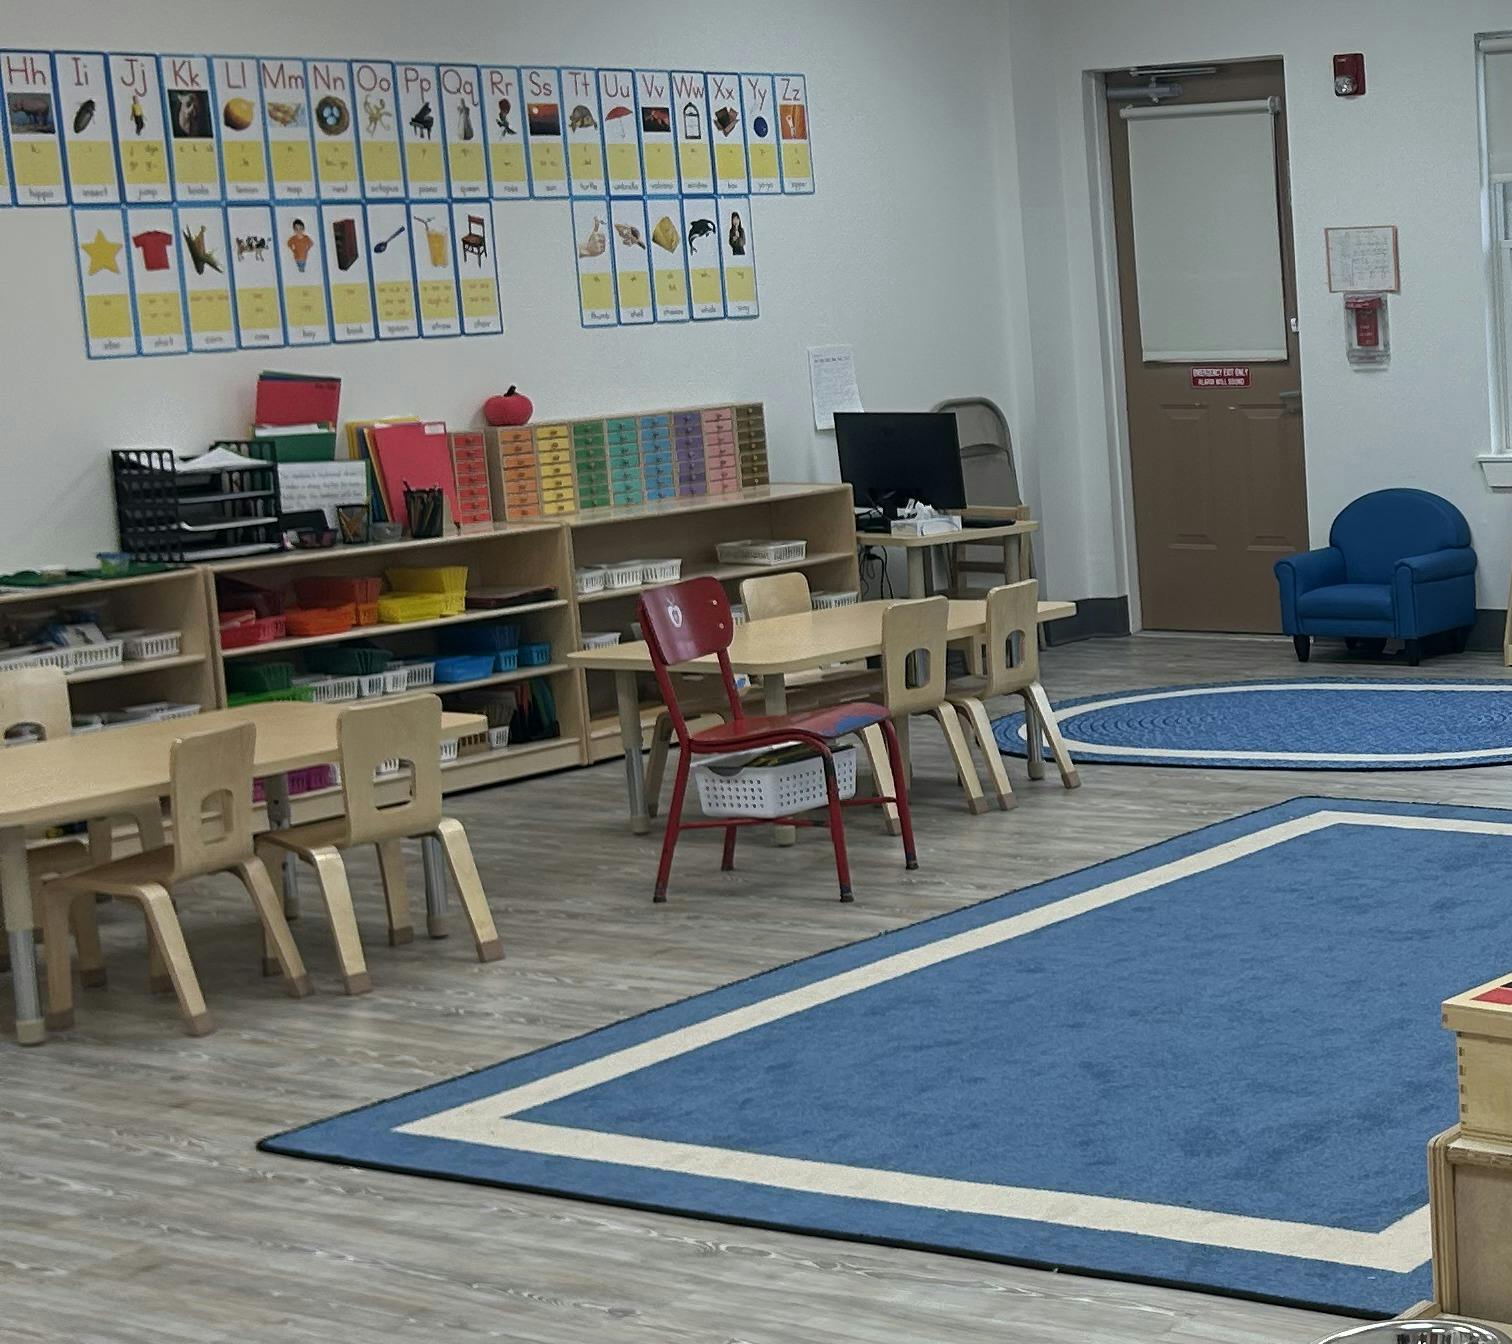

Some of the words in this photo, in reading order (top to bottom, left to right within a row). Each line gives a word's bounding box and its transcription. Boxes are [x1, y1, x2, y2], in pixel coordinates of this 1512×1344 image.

[7, 56, 46, 85] Hh
[72, 58, 88, 86] Ii
[120, 59, 147, 97] Jj
[172, 60, 200, 86] Kk
[225, 62, 246, 89] Ll
[262, 63, 304, 89] Mm
[314, 64, 345, 90] Nn
[357, 65, 390, 92] Oo
[490, 70, 512, 96] Rr
[404, 67, 431, 103] Pp
[442, 69, 478, 106] Qq
[530, 71, 552, 97] Ss
[568, 72, 590, 97] Tt
[604, 74, 630, 98] Uu
[642, 75, 664, 98] Vv
[674, 76, 704, 99] Ww
[713, 77, 734, 100] Xx
[748, 78, 767, 111] Yy
[781, 78, 800, 101] Zz
[1223, 368, 1234, 376] EXIT
